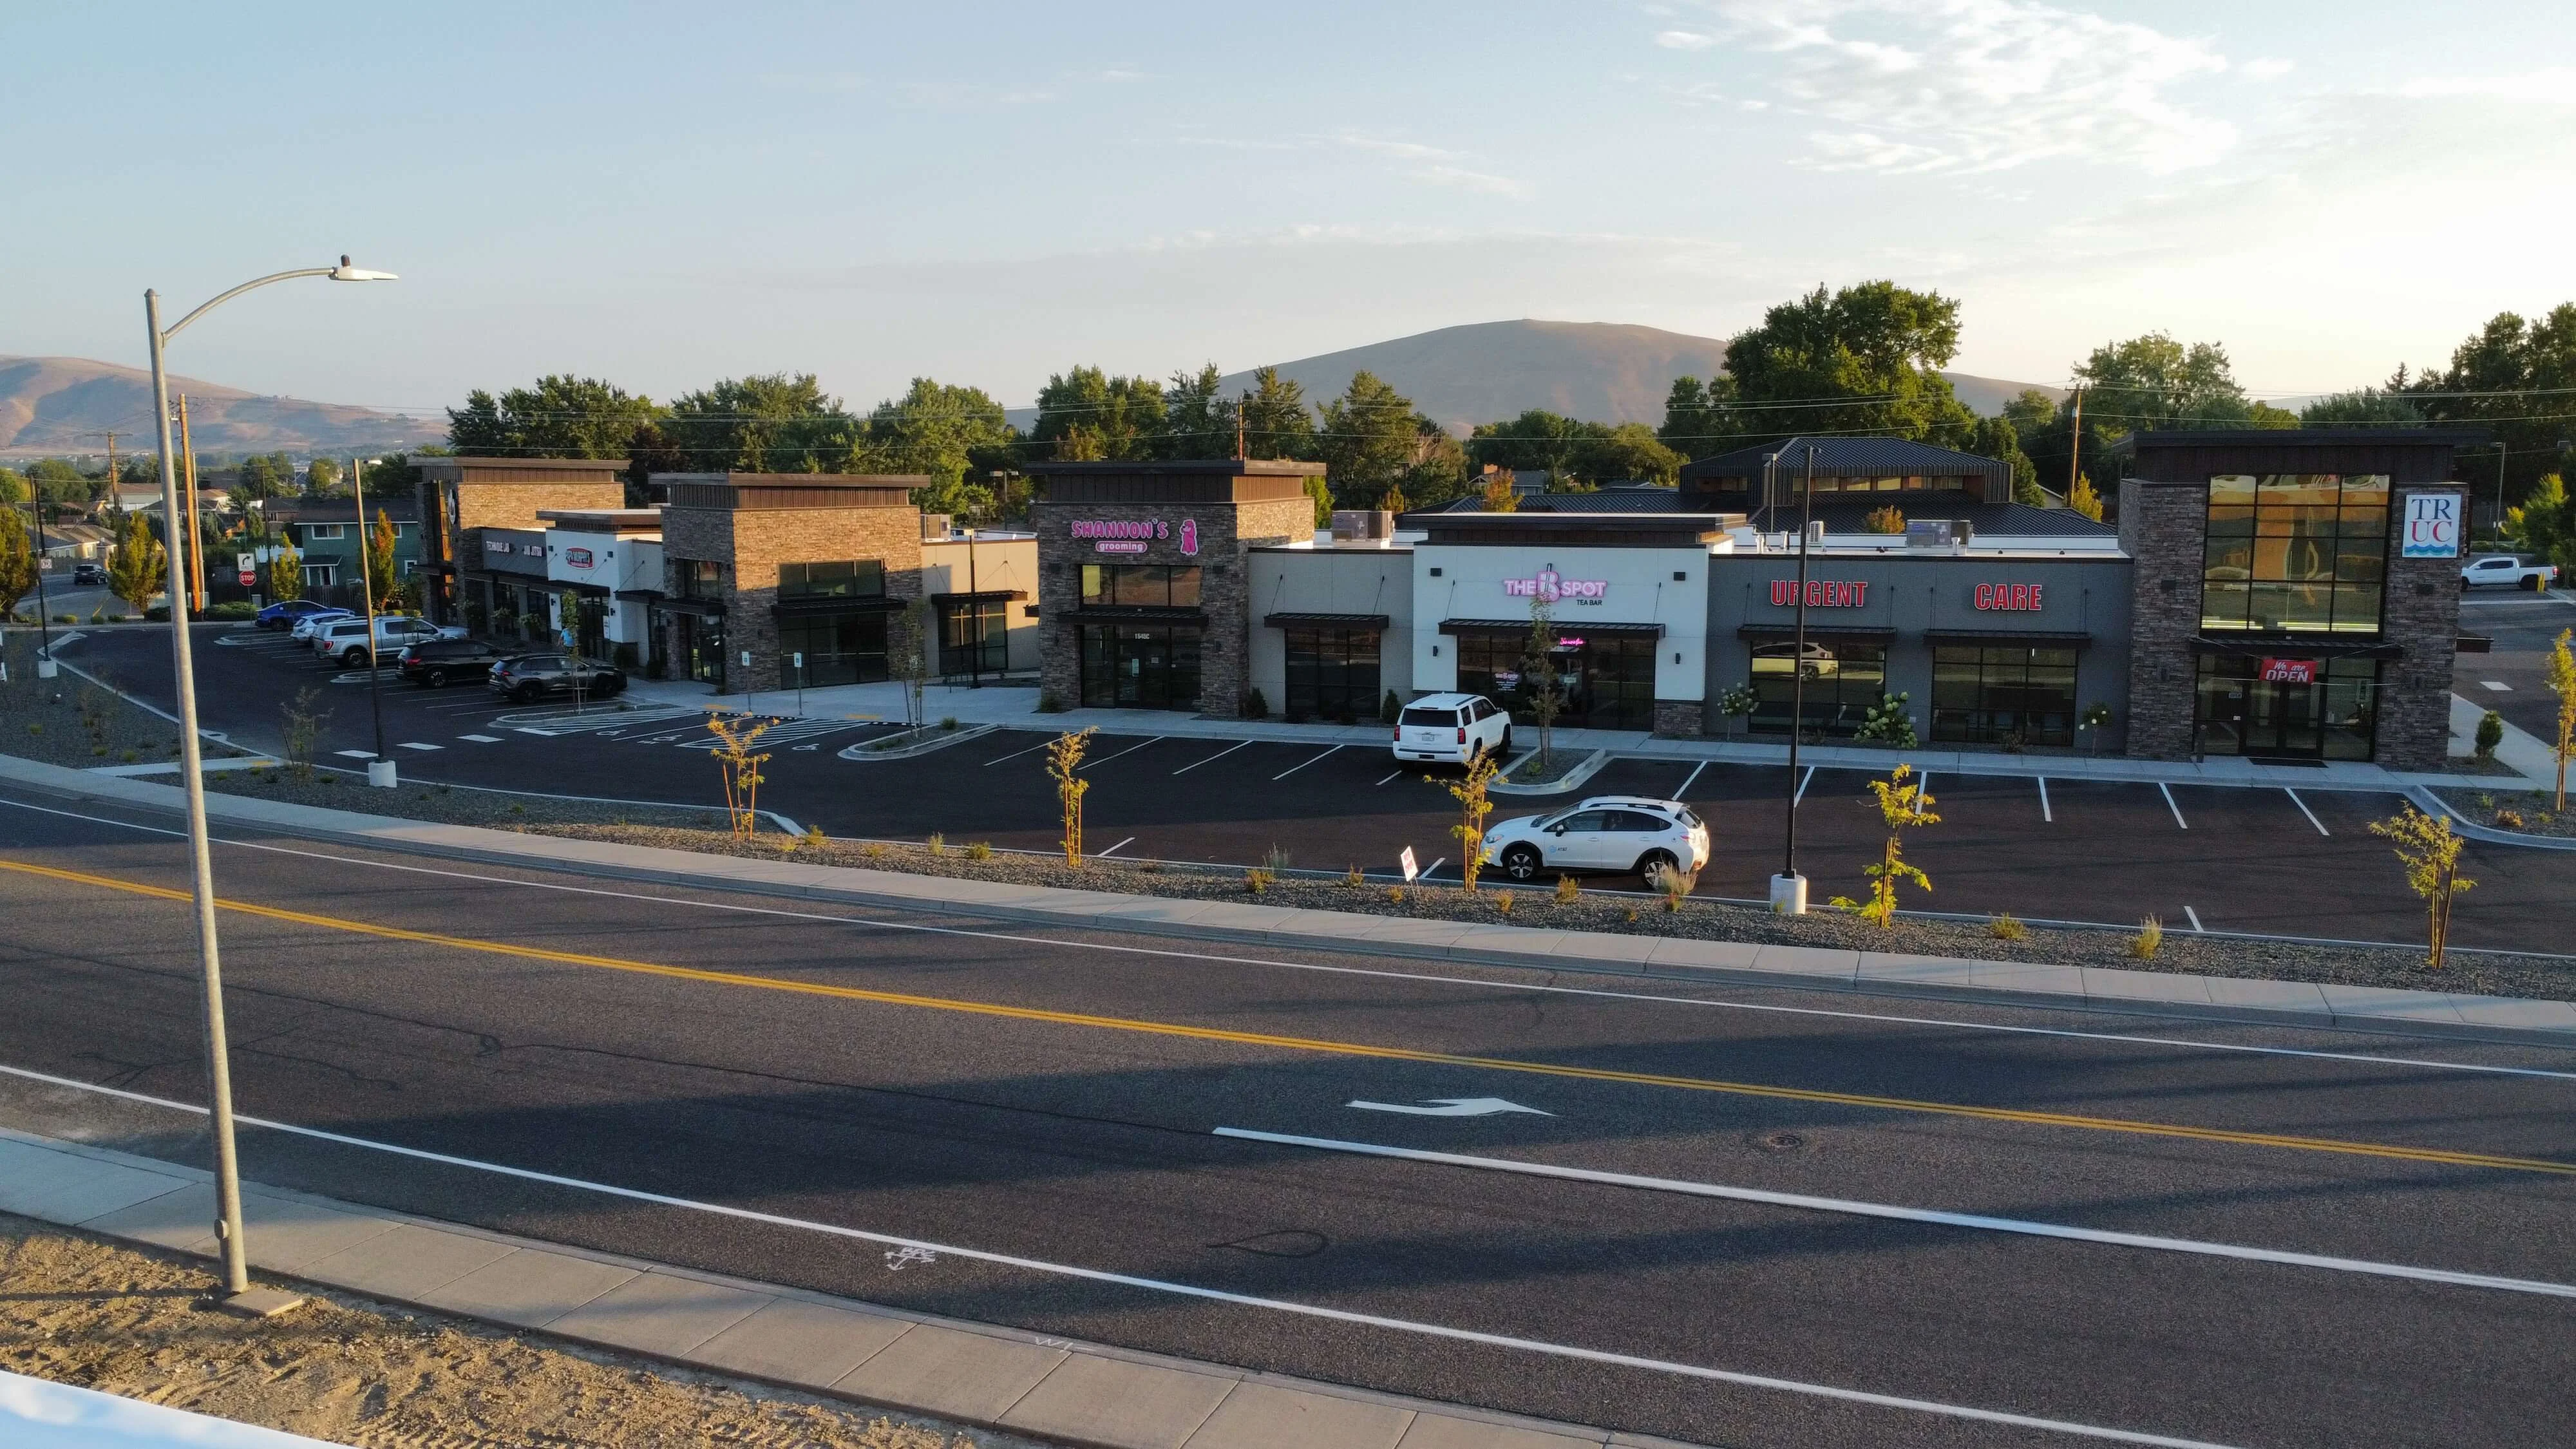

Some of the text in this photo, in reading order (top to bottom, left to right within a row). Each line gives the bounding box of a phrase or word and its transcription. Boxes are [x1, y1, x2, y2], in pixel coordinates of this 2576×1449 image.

[2411, 499, 2452, 520] TR
[1072, 518, 1169, 539] SHANNON'S
[2410, 521, 2452, 542] UC
[1099, 542, 1143, 552] grooming
[1504, 571, 1607, 602] THE B SPOT
[1771, 580, 2042, 611] URGENT CARE
[2266, 670, 2309, 683] OPEN
